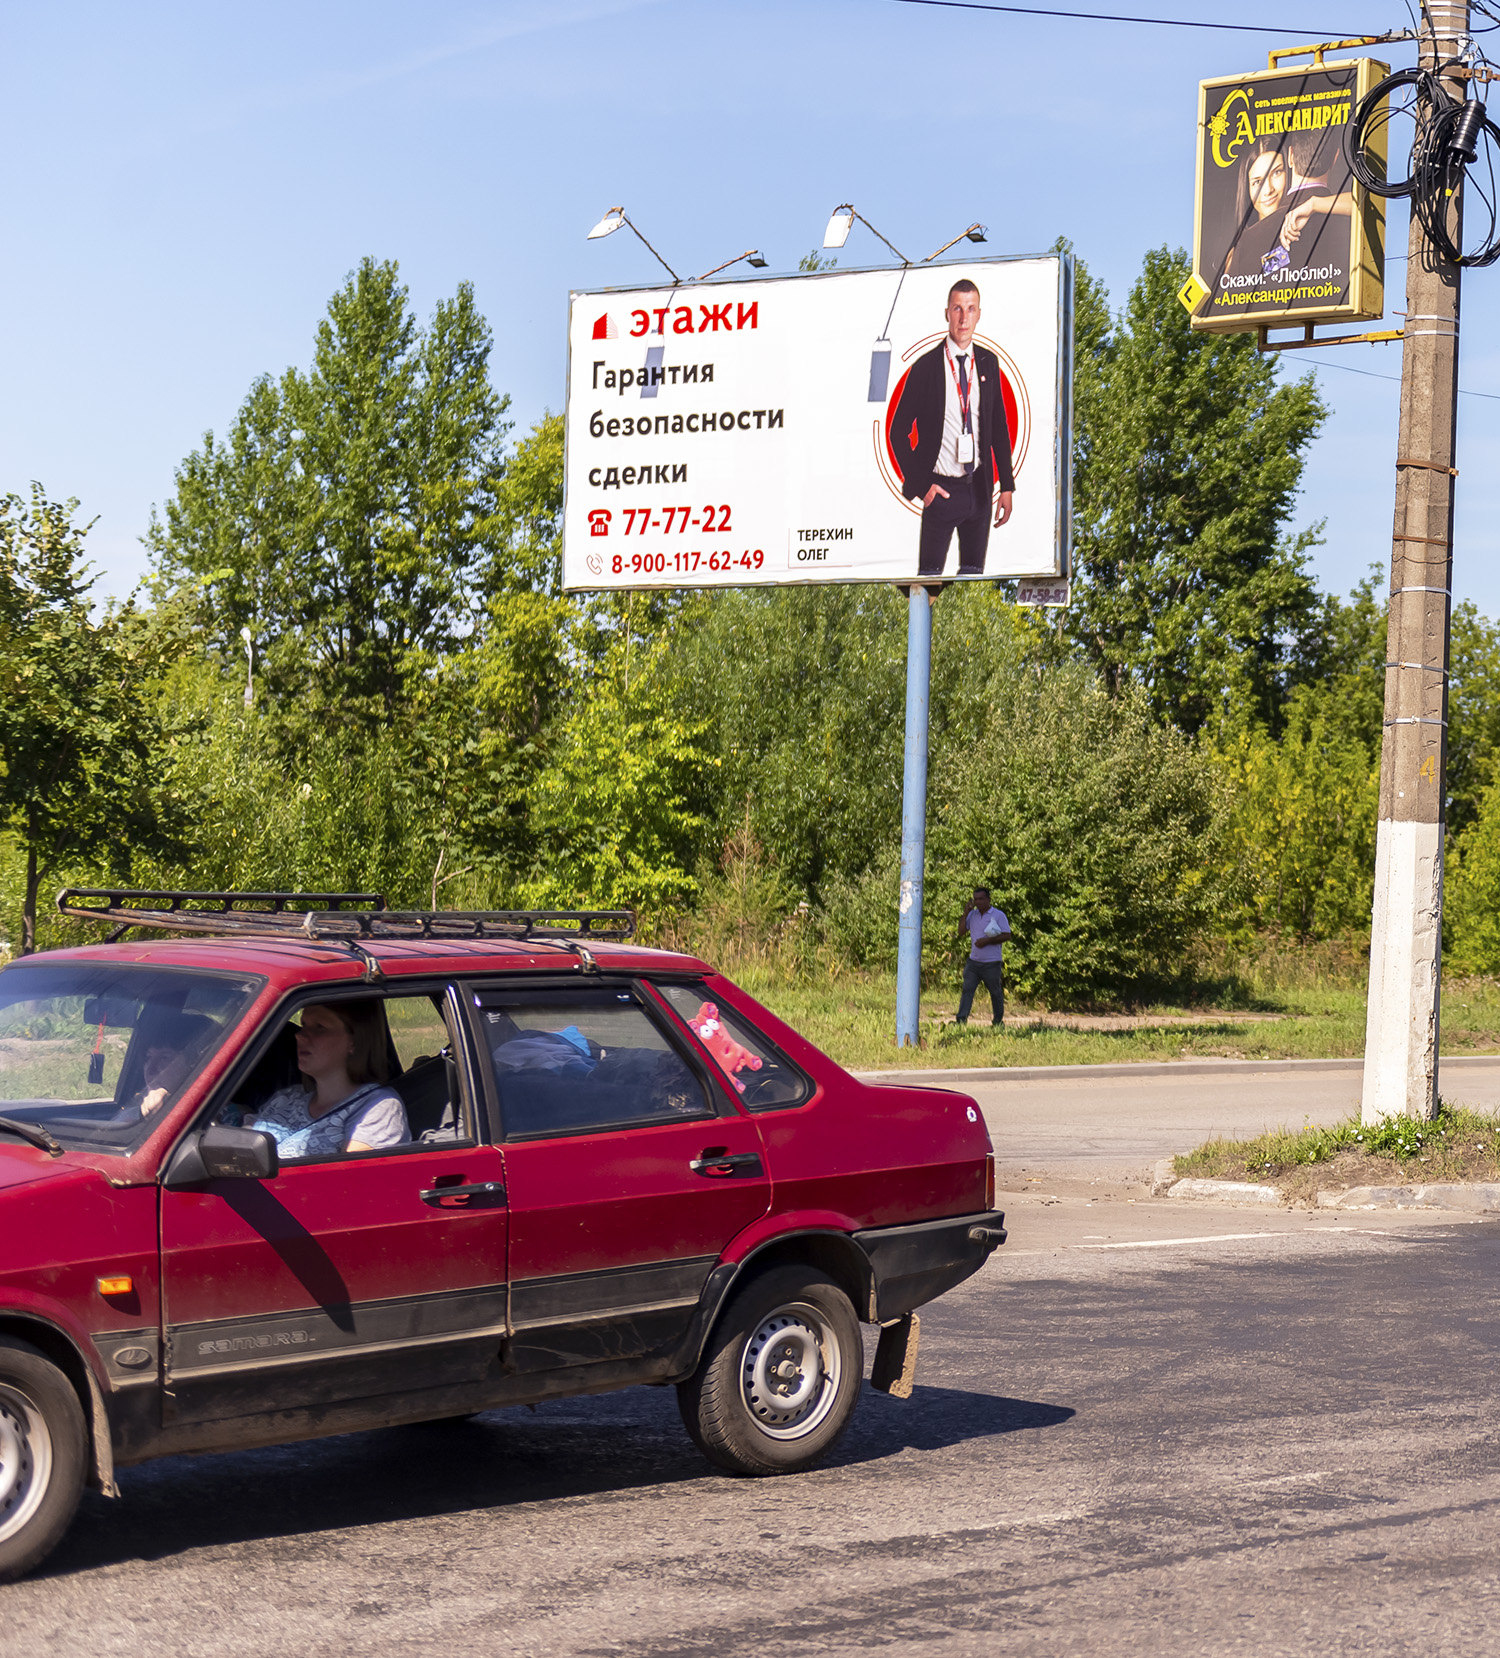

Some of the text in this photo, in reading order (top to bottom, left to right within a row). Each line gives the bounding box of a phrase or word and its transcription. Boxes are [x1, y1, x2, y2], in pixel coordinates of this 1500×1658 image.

[1254, 100, 1270, 109] сеть
[1220, 264, 1342, 289] Скажи: «Люблю!»
[1214, 282, 1341, 306] «Александриткой»
[629, 301, 760, 338] этажи
[592, 360, 714, 395] Гарантия
[588, 408, 785, 438] безопасности
[588, 462, 688, 490] сделки
[622, 504, 733, 536] 77-77-22
[796, 527, 854, 542] ТЕРЕХИН
[611, 549, 765, 574] 8-900-117-62-49
[796, 547, 830, 562] ОЛЕГ
